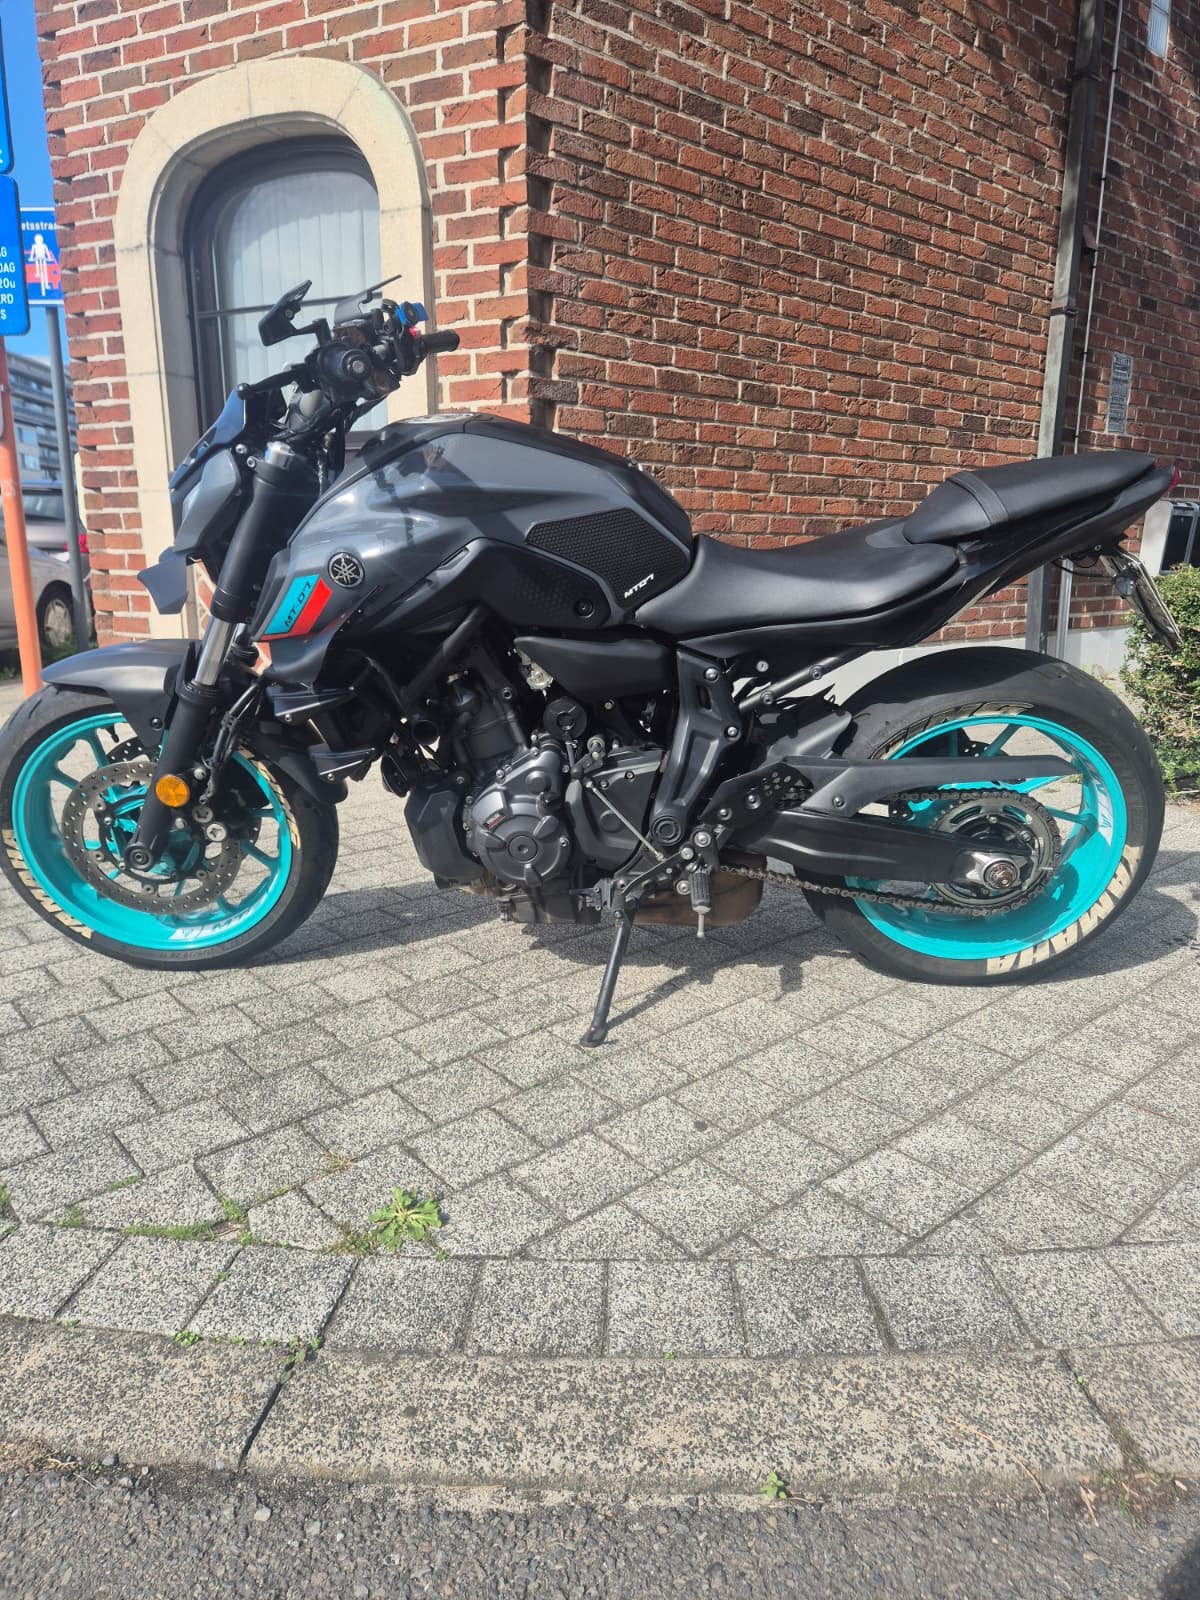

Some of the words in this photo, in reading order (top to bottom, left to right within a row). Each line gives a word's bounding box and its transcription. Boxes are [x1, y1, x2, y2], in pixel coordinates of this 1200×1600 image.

[284, 581, 312, 627] MT-07
[2, 829, 92, 939] YAMAHA
[986, 844, 1144, 976] YAMAHA
